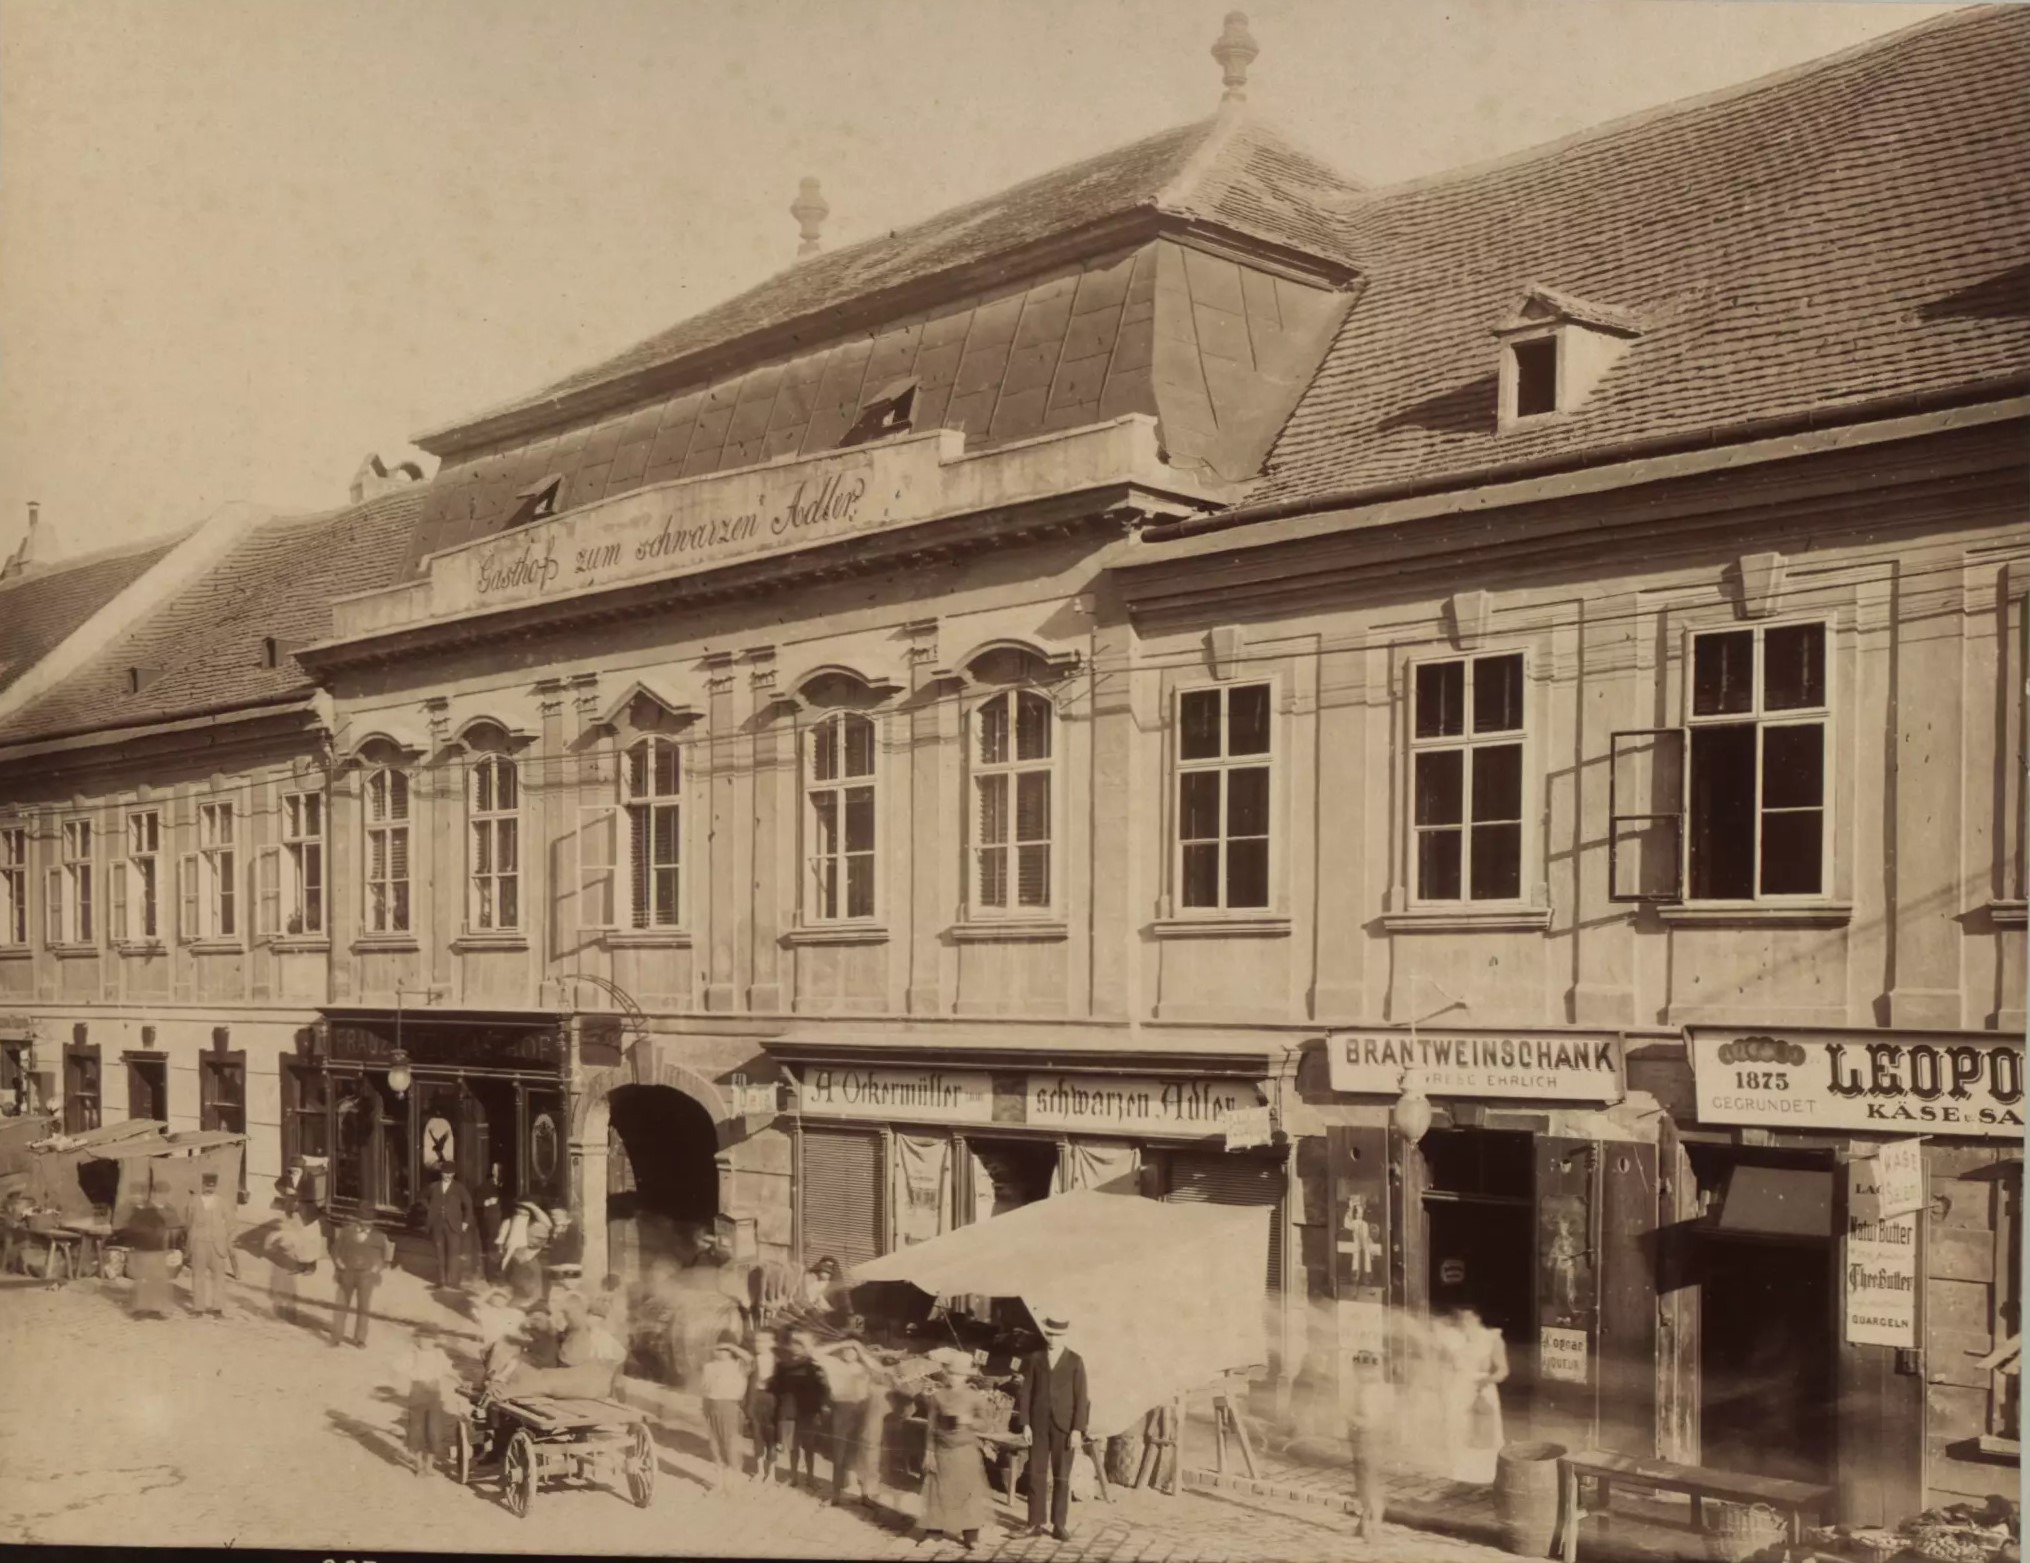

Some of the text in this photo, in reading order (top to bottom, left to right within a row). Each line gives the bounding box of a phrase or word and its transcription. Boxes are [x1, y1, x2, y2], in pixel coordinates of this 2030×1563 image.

[477, 535, 559, 593] Gasthof
[574, 543, 621, 574] zum
[635, 515, 758, 560] schwarzen
[1345, 1038, 1616, 1072] BRANTWEINSCHANK
[1487, 1074, 1557, 1088] EHRLICH
[1735, 1071, 1790, 1091] 1875
[1825, 1042, 2024, 1106] LEOPO
[1036, 1077, 1150, 1121] schwarzen
[1851, 1315, 1909, 1329] QUARGELN
